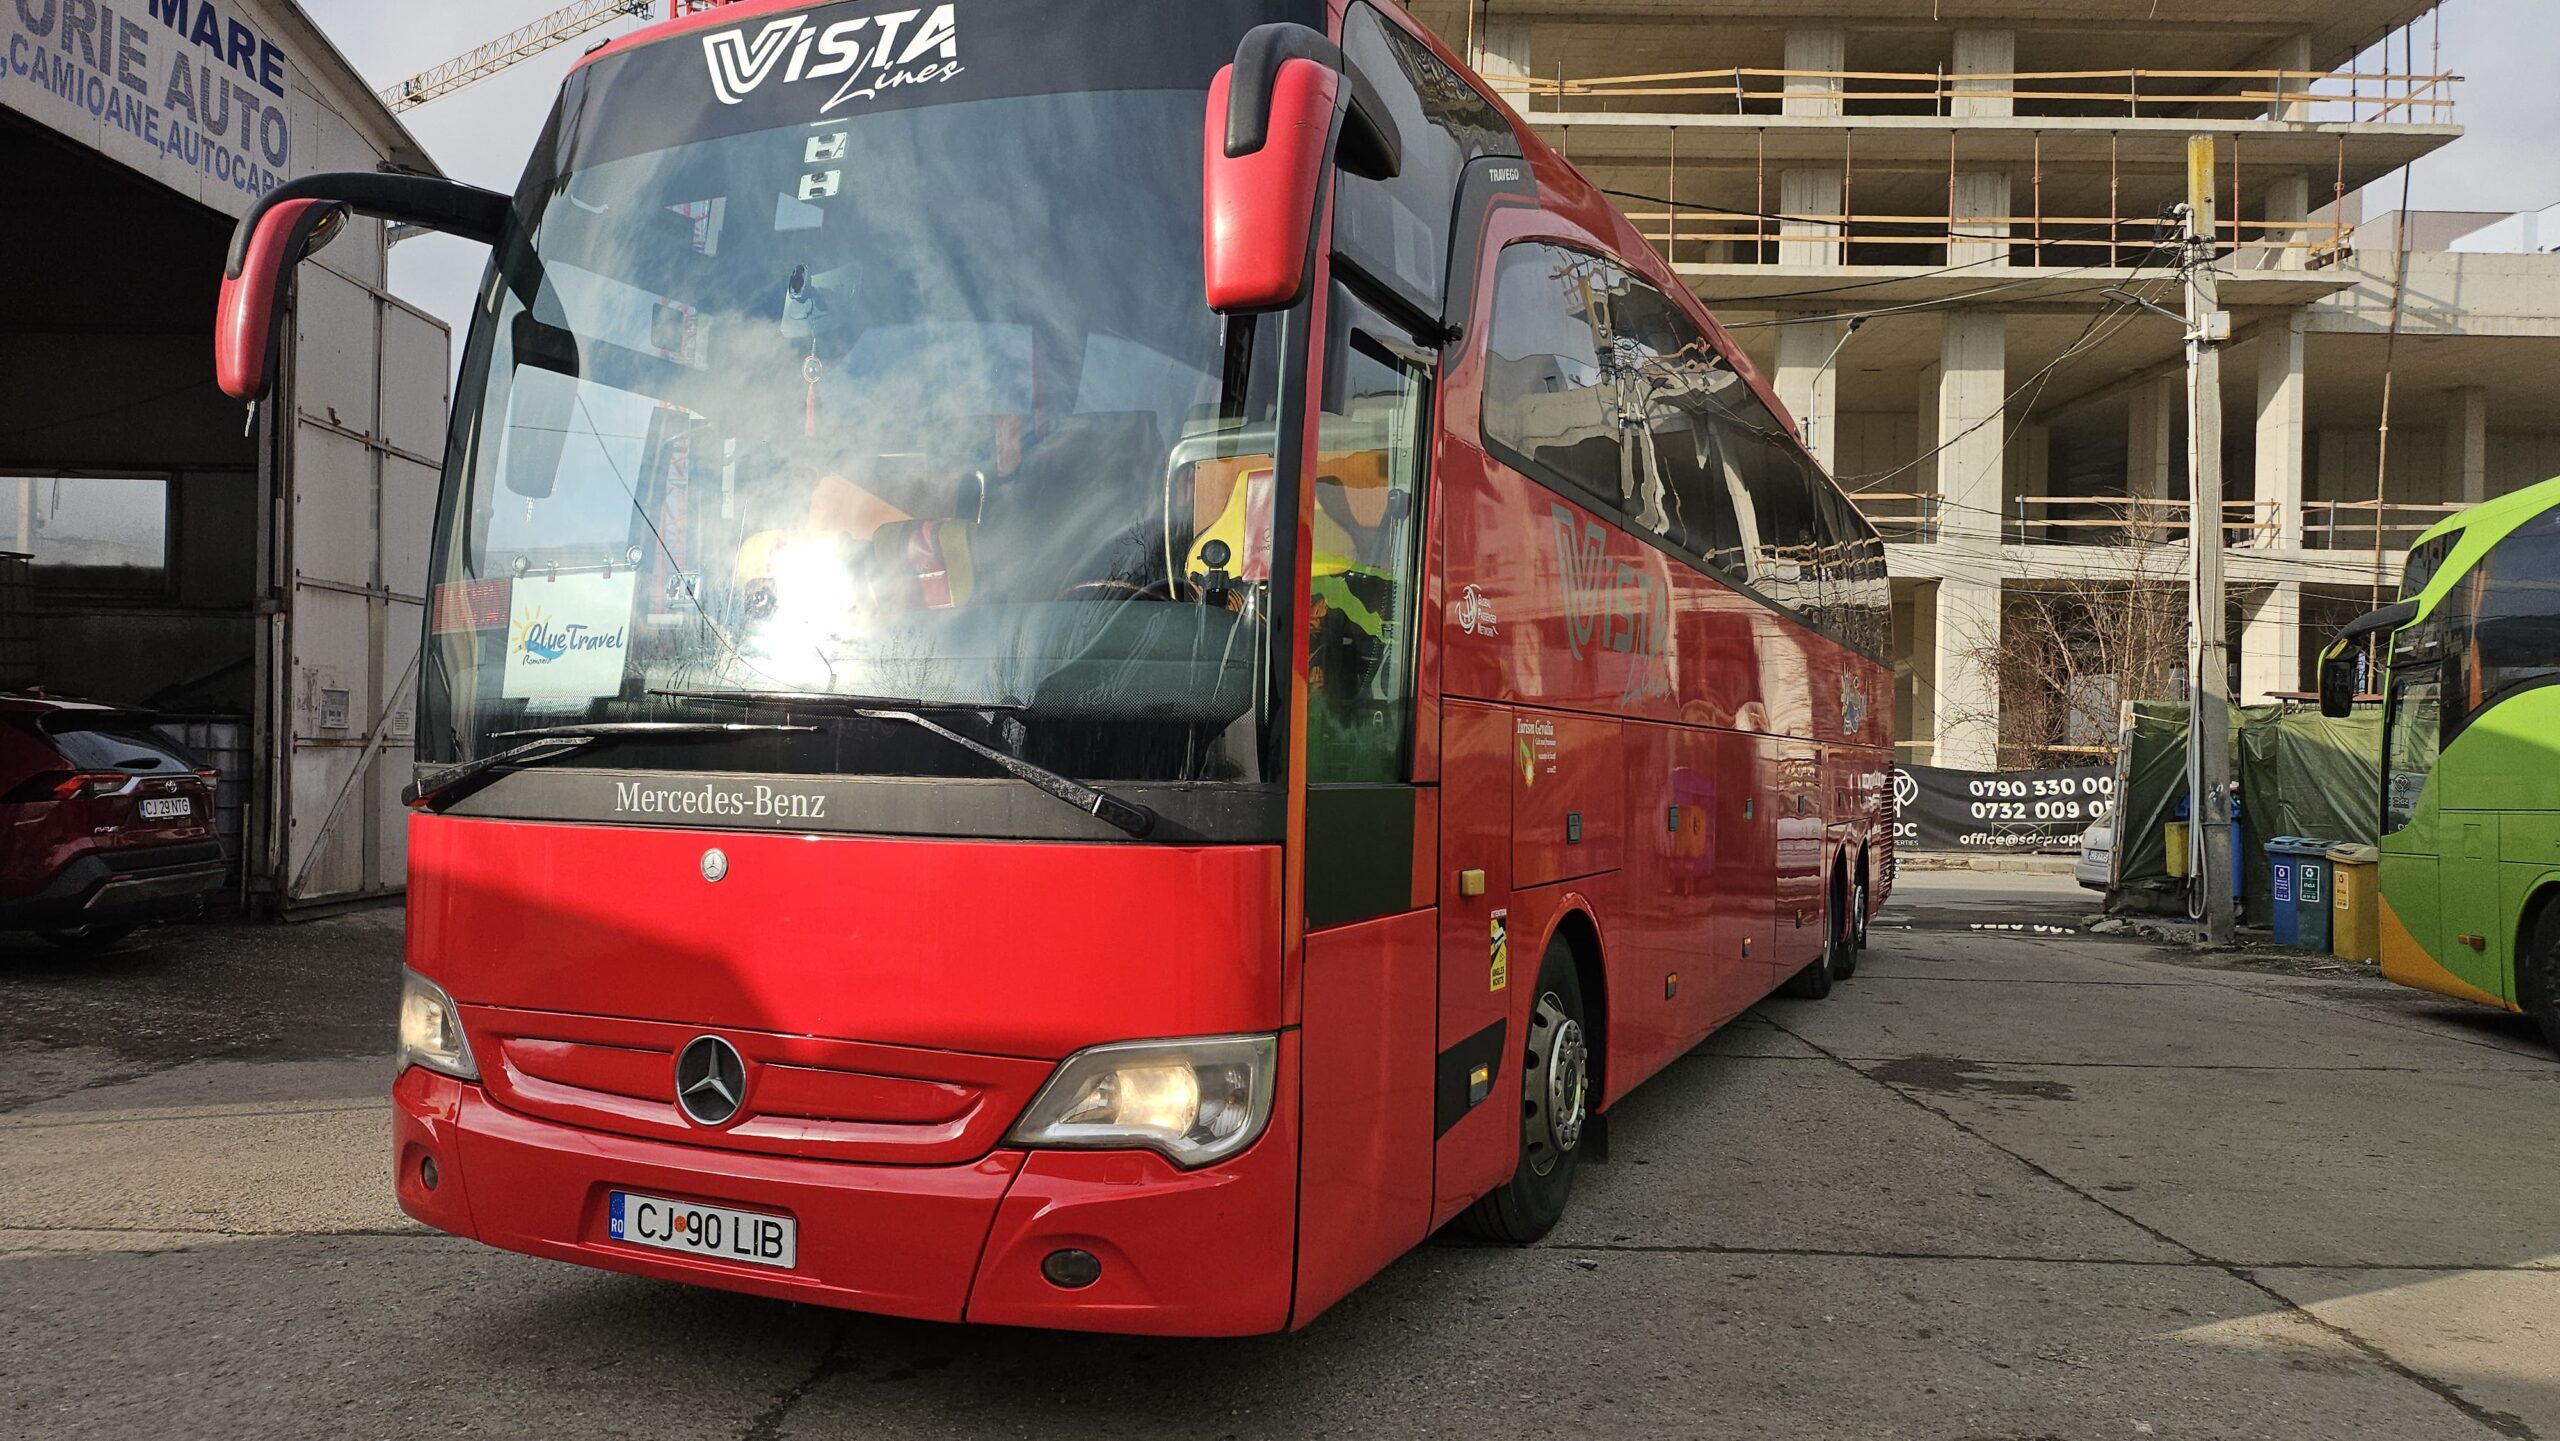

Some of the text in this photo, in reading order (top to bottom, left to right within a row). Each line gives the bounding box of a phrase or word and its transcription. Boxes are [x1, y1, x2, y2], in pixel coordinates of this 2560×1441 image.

[148, 0, 285, 99] MARE
[820, 47, 965, 114] Lines
[164, 50, 288, 168] AUTO
[1489, 168, 1519, 182] TRAVEGO
[615, 782, 826, 818] Mercedes-Benz
[1969, 776, 2116, 797] 0790 330 00
[146, 799, 188, 815] CJ 29 NTG
[1971, 801, 2026, 819] 0732
[2035, 801, 2080, 819] 009
[611, 1218, 624, 1234] RO
[637, 1202, 784, 1259] CJ 90 LIB
